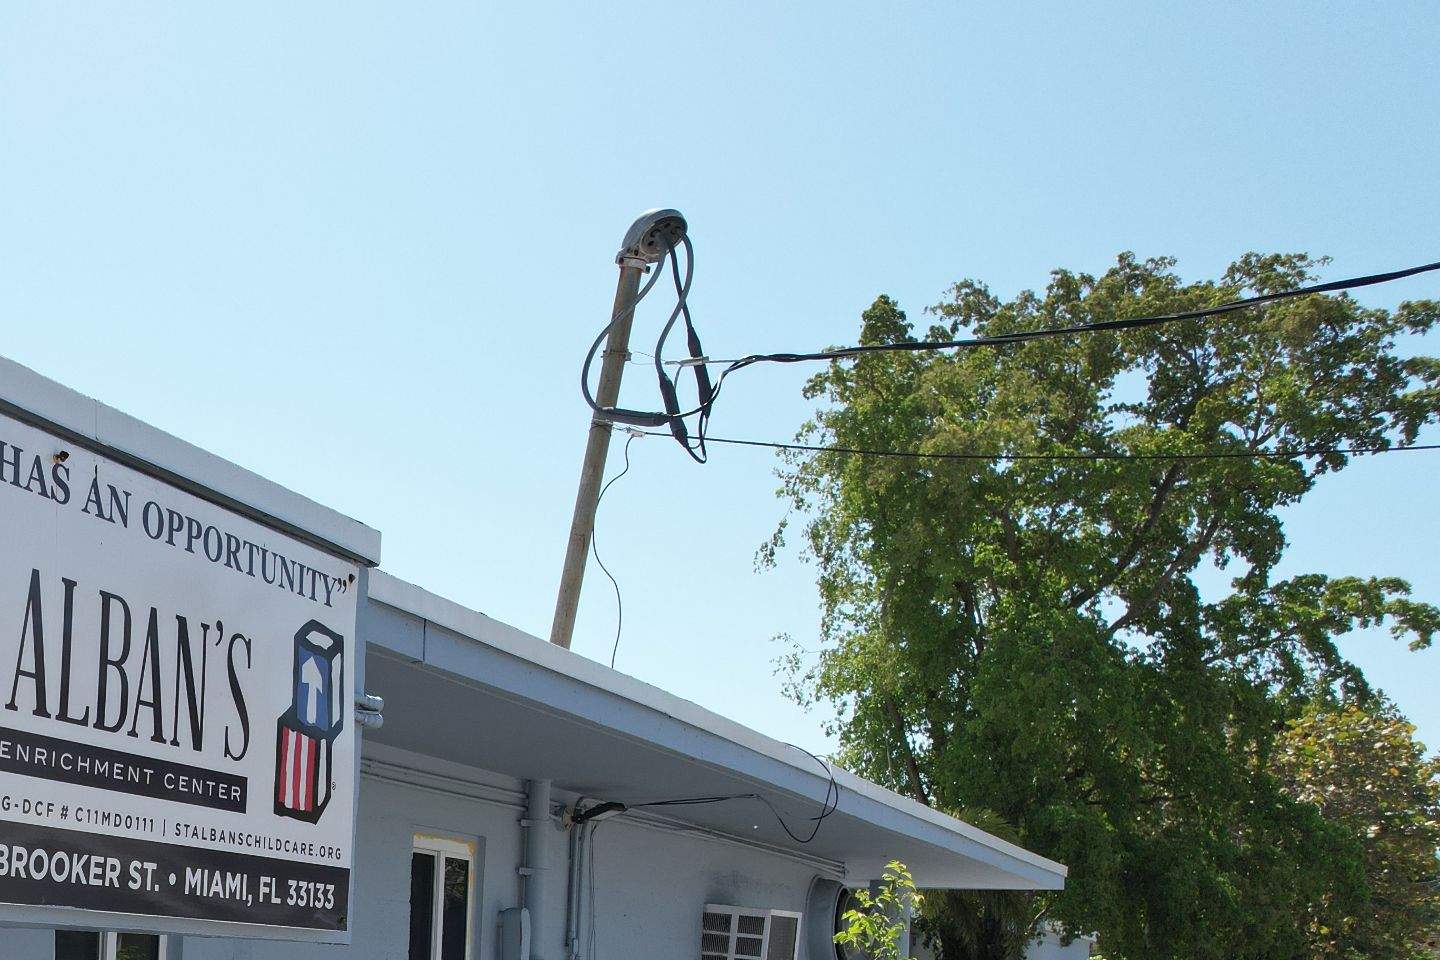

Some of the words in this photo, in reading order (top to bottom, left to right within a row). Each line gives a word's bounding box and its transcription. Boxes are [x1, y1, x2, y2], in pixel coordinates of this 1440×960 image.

[81, 474, 131, 528] AN
[4, 568, 252, 762] ALBAN’S
[0, 741, 154, 785] ENRICHMENT
[164, 773, 242, 802] CENTER
[174, 822, 342, 860] STALBANSCHILDCARE.ORG
[129, 860, 160, 892] ST.
[184, 867, 253, 907] MIAMI,
[259, 876, 281, 906] FL
[286, 879, 335, 910] 33133
